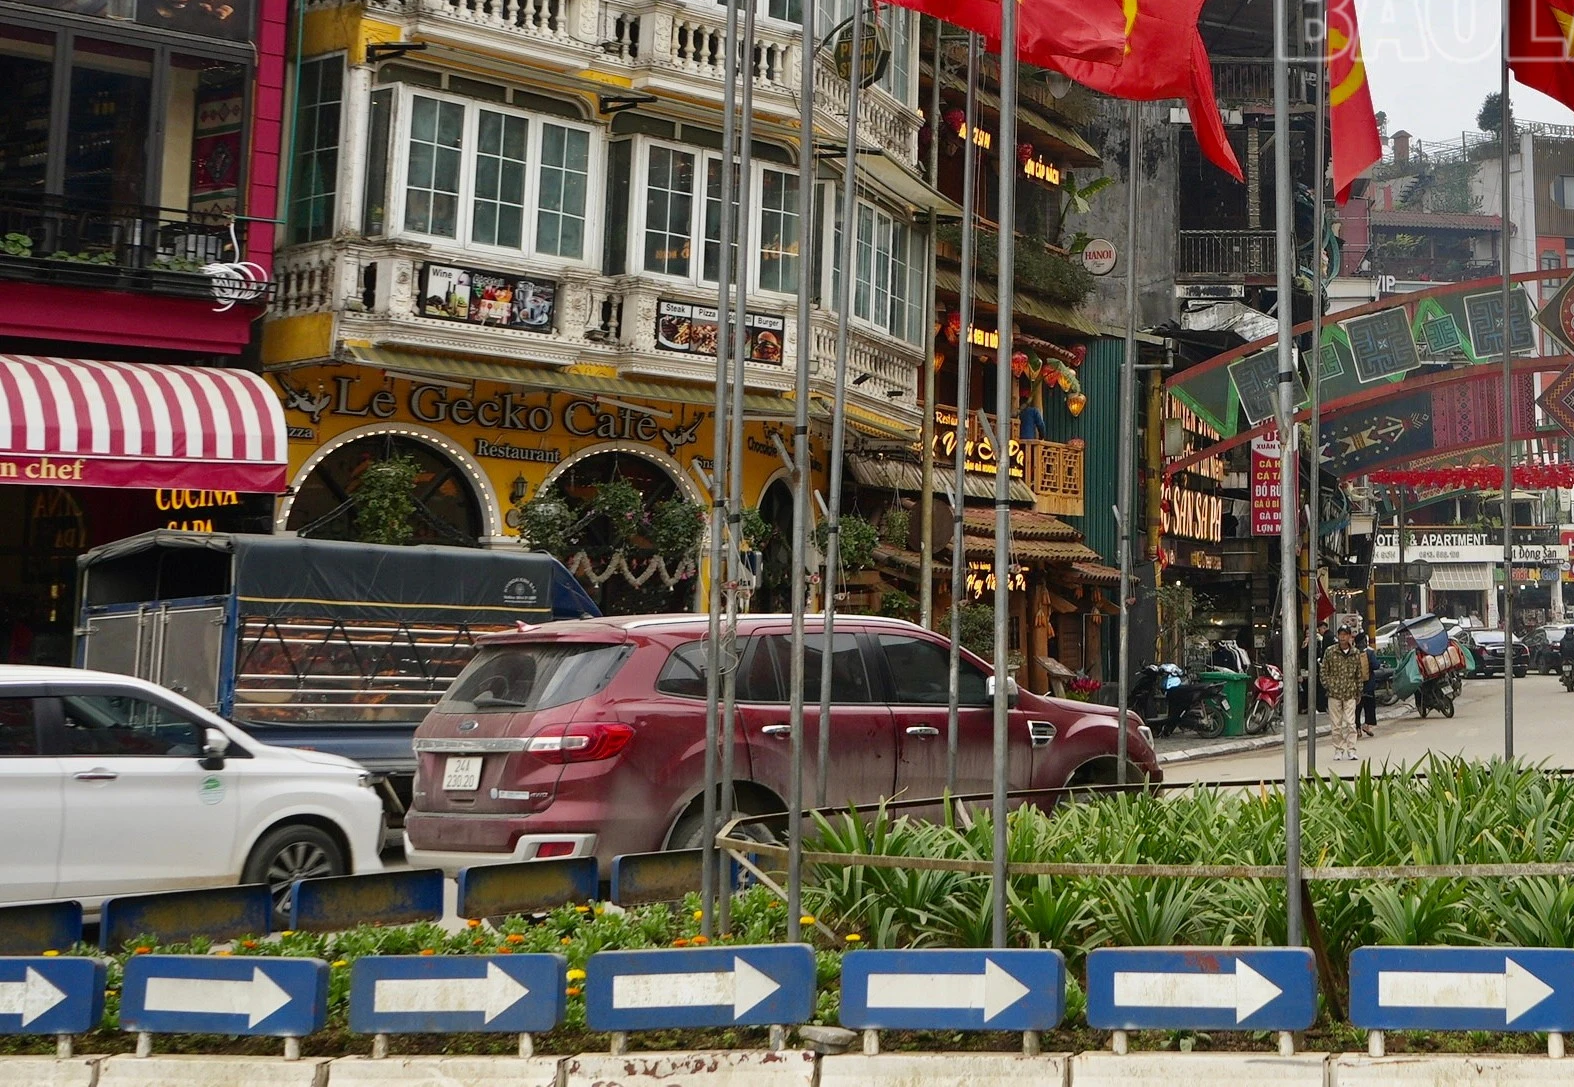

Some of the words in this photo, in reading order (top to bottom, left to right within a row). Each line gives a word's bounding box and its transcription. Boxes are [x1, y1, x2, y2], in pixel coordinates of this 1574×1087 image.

[840, 39, 874, 58] PIA
[840, 58, 874, 78] STK
[1085, 249, 1112, 261] HANOI
[432, 268, 453, 280] Wine
[665, 303, 687, 314] Steak
[698, 308, 717, 320] Pizza
[757, 317, 781, 328] Burger
[333, 376, 398, 419] Le
[409, 383, 555, 434] Gecko
[563, 398, 660, 442] Café
[287, 426, 314, 440] zza
[475, 437, 562, 465] Restaurant
[25, 458, 87, 481] chef
[1259, 458, 1272, 469] CÁ
[1256, 470, 1270, 481] CÁ
[155, 489, 240, 512] CUCINA
[1376, 533, 1400, 546] OTE
[1409, 533, 1418, 546] &
[1420, 533, 1488, 546] APARTMENT
